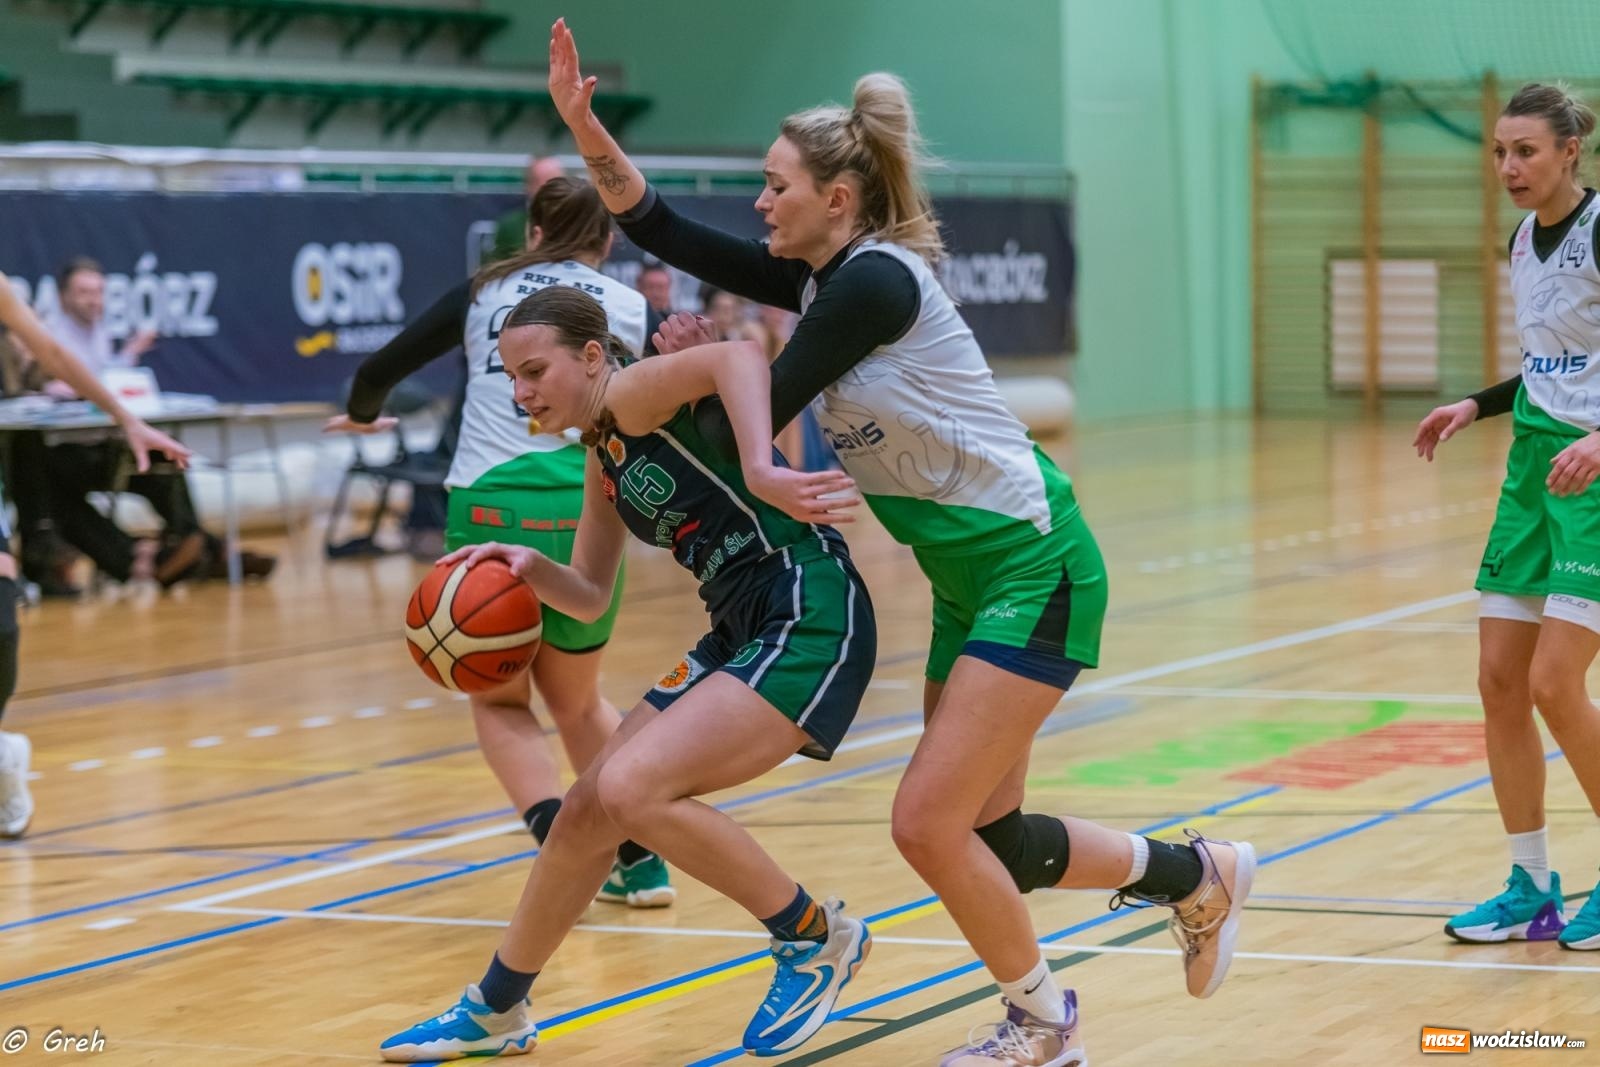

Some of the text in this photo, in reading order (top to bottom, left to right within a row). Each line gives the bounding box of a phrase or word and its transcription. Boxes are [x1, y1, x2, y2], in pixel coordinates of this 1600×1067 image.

[1559, 239, 1586, 268] 14
[524, 272, 560, 286] RKK
[620, 455, 676, 520] 15
